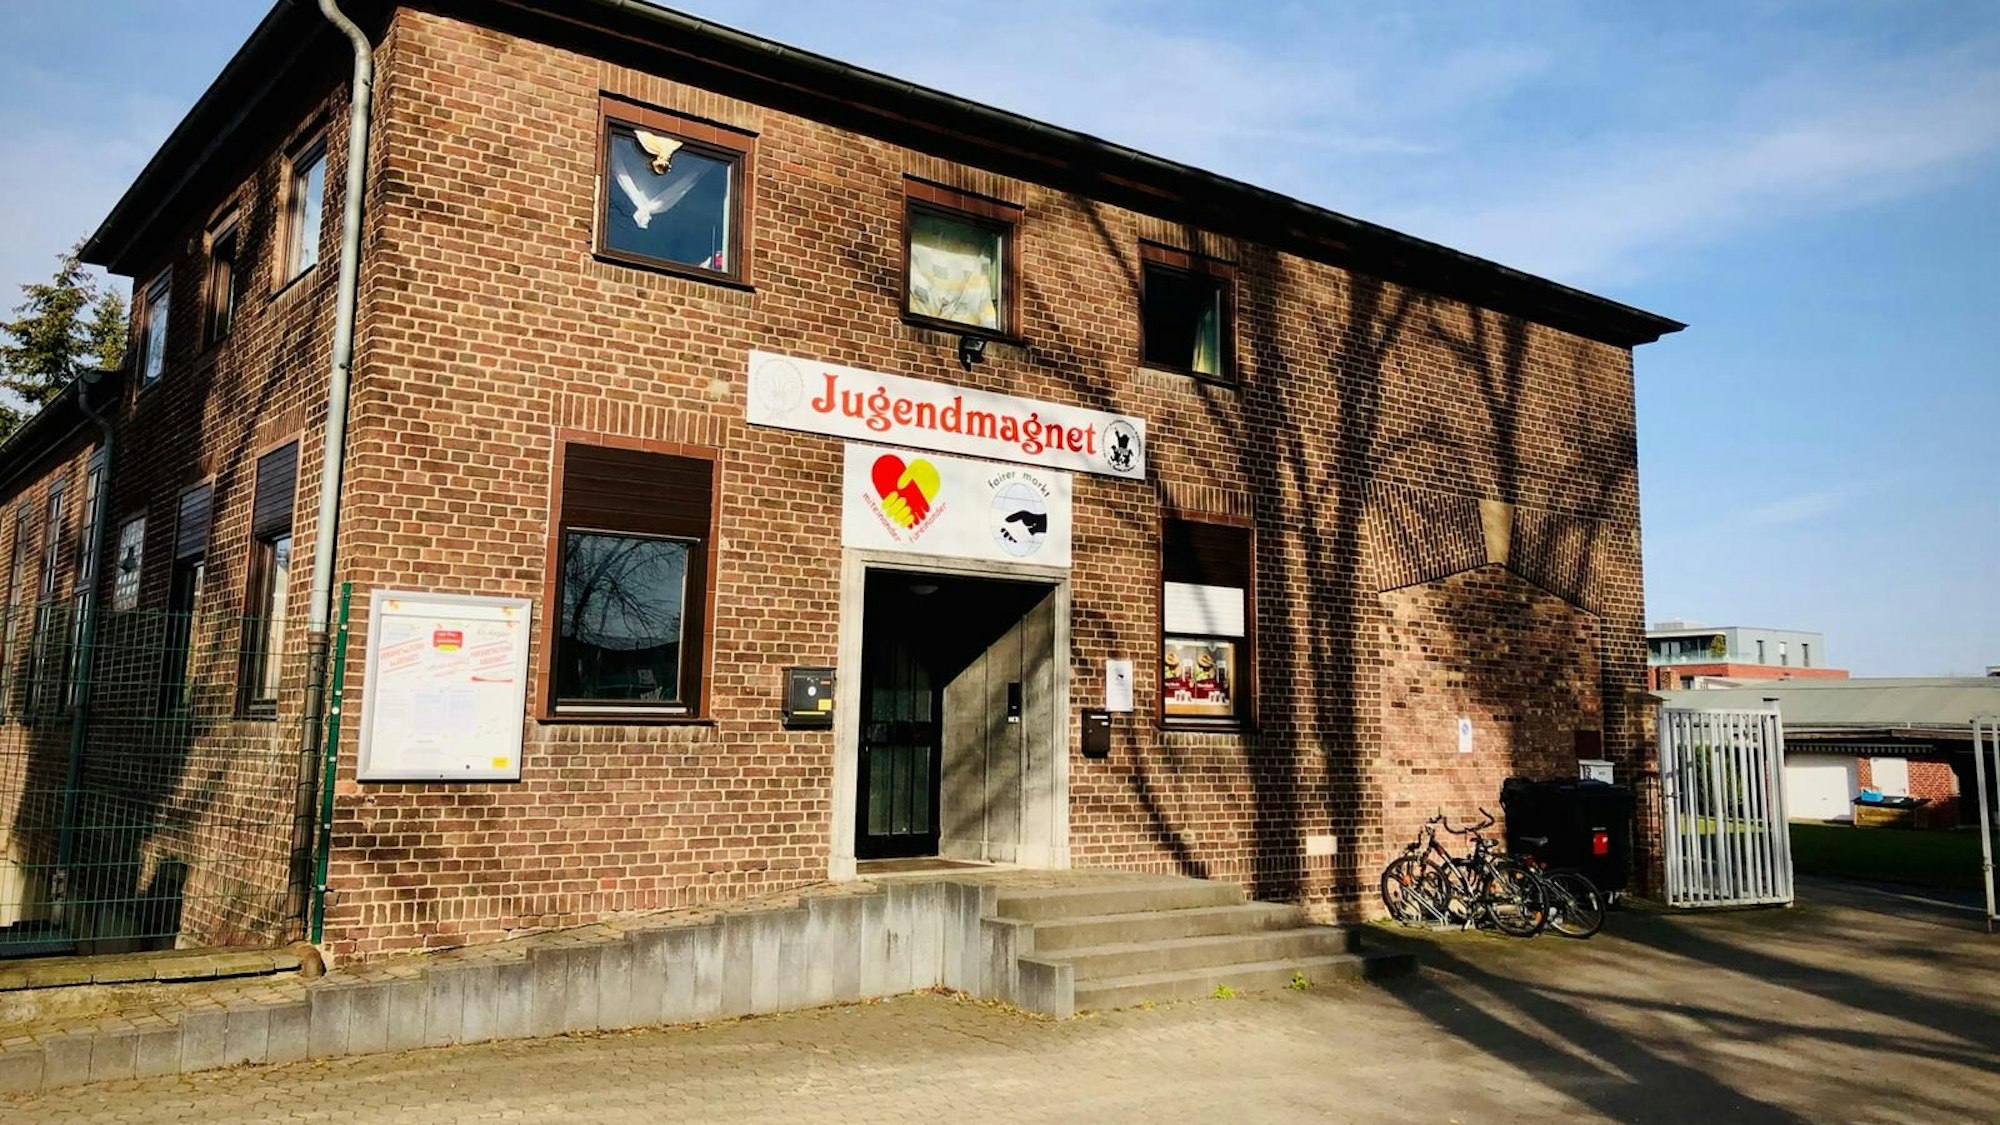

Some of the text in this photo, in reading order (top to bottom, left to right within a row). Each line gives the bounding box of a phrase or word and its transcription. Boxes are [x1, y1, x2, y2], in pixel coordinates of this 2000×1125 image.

[811, 372, 1097, 455] Jugendmagnet
[987, 471, 1051, 498] fairer markt
